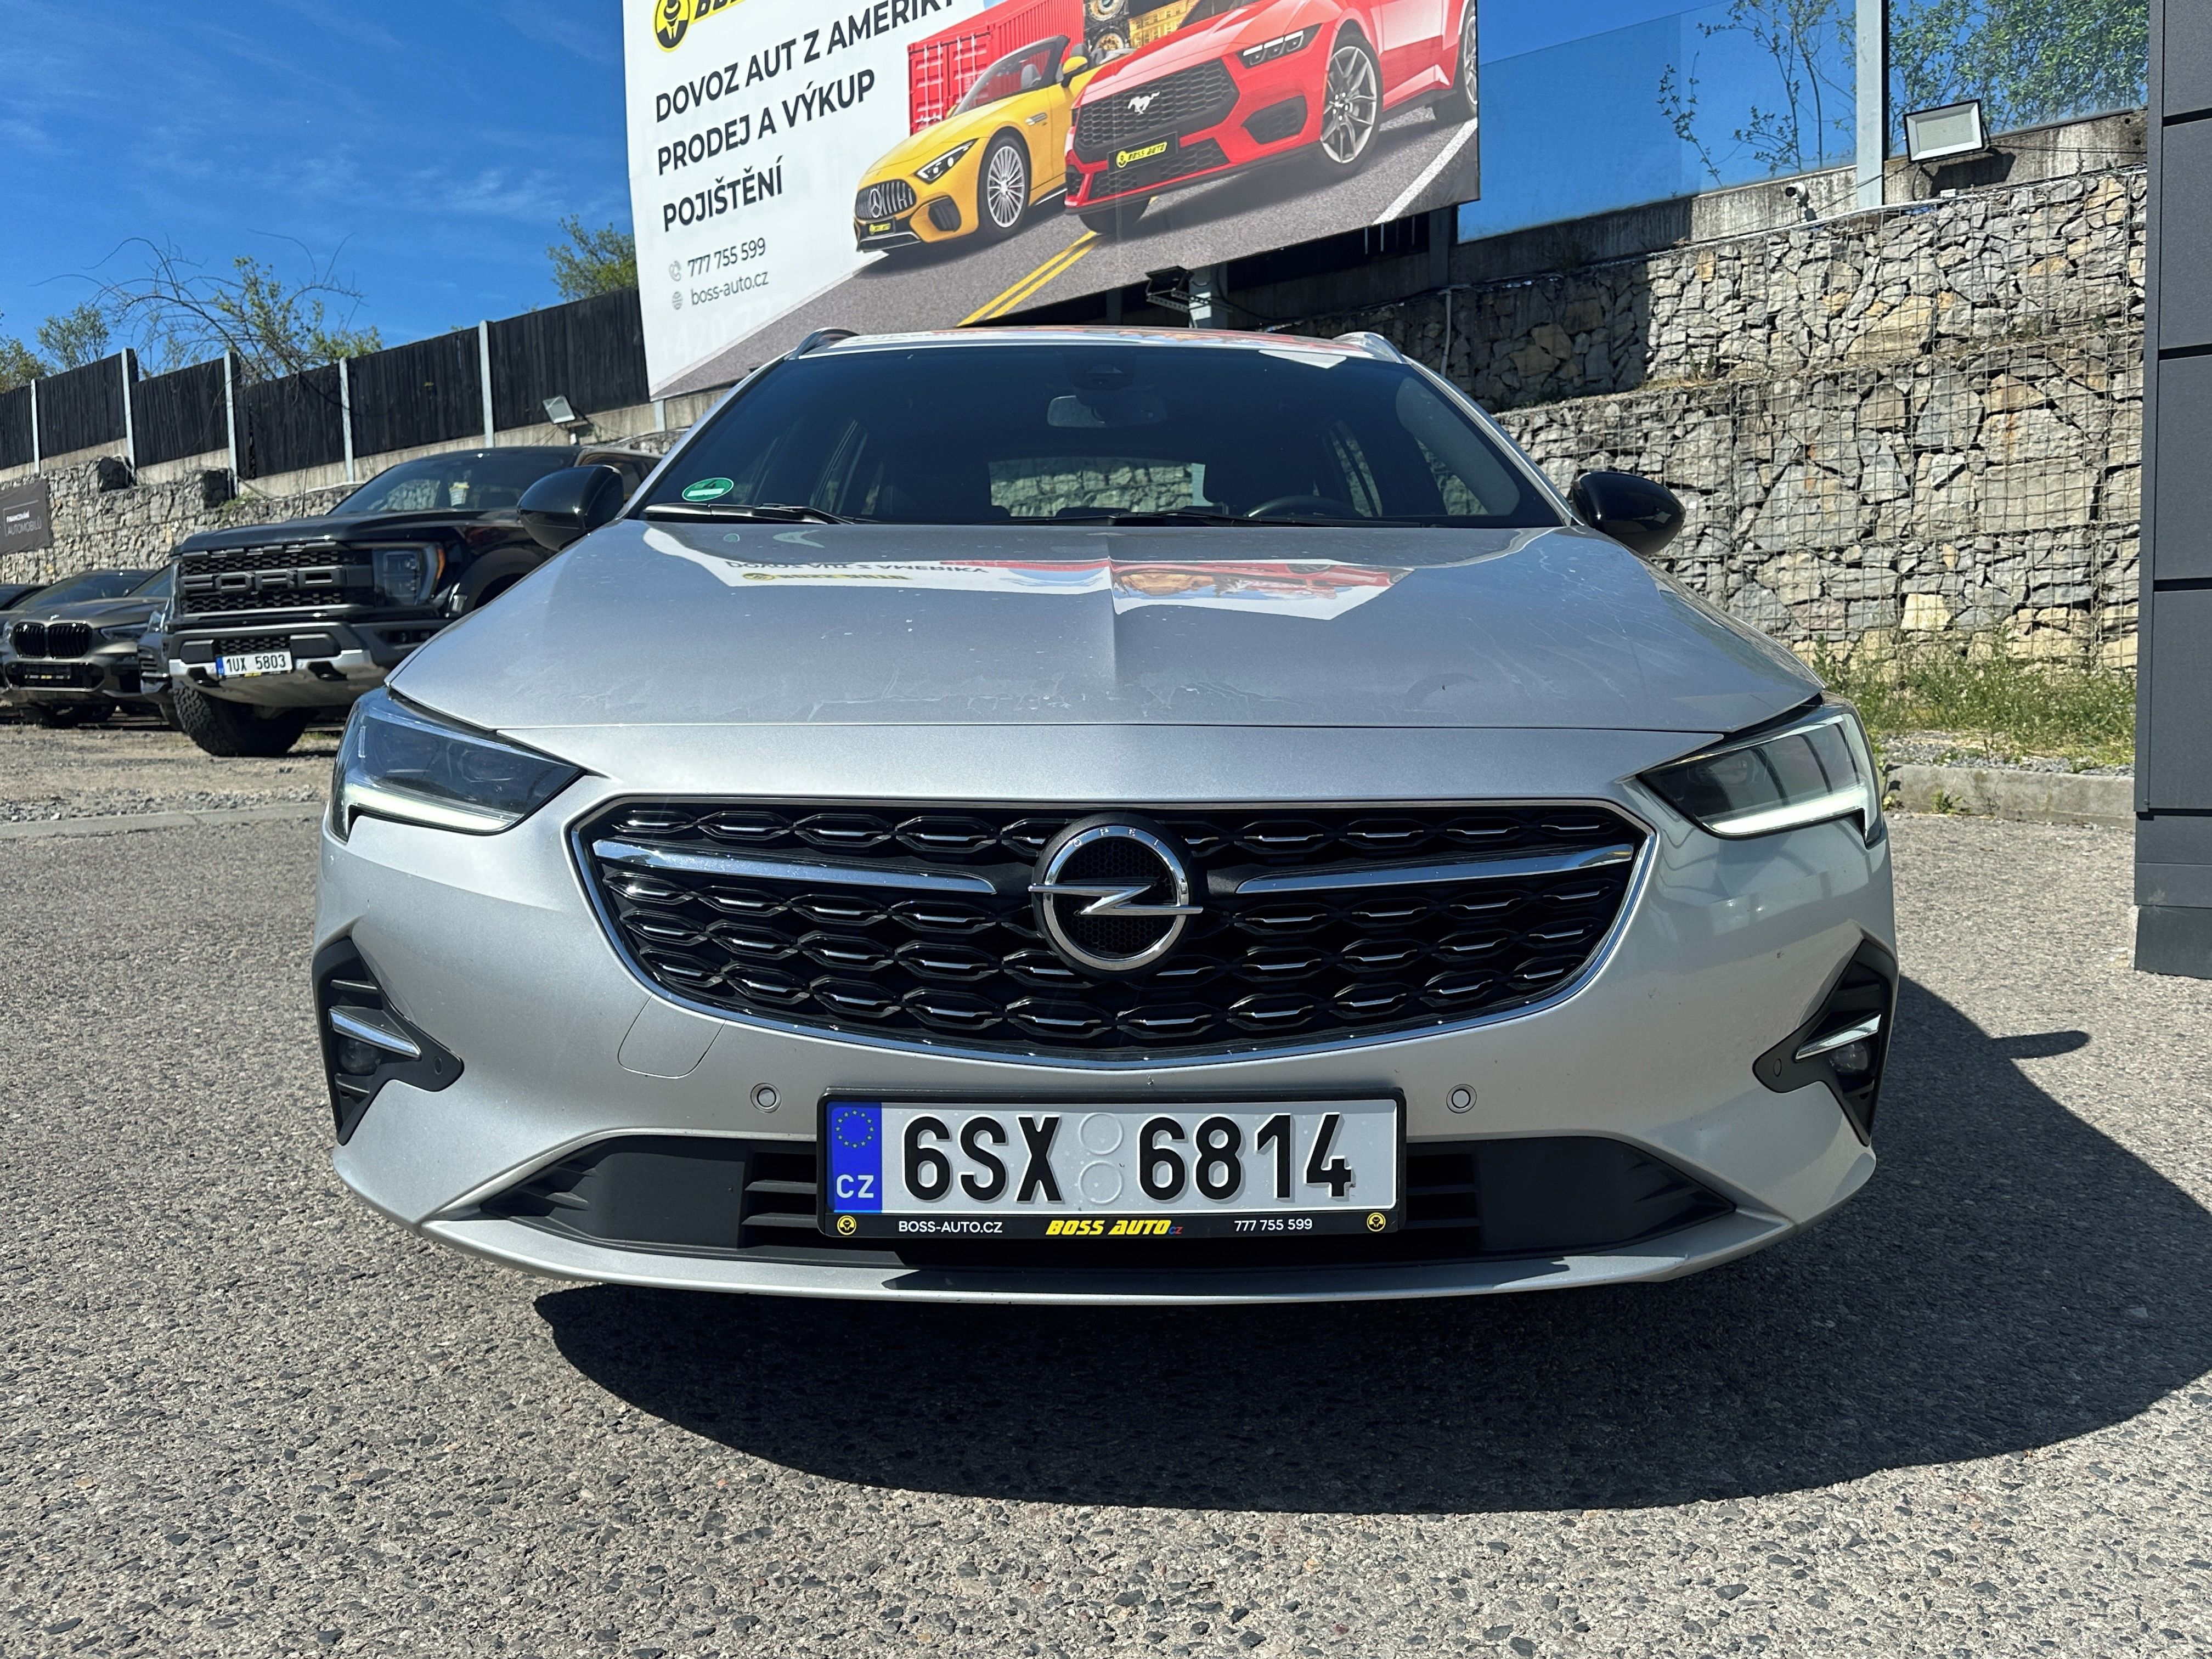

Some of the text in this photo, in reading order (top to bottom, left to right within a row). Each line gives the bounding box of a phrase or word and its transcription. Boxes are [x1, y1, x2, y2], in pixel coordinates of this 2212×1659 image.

[656, 62, 739, 123] DOVOZ
[745, 38, 797, 87] AUT
[804, 29, 820, 64] Z
[658, 69, 875, 176] PRODEJ A VÝKUP
[663, 155, 783, 233] POJIŠTĚNÍ
[687, 238, 766, 277] 777 755 599
[691, 271, 769, 306] boss-auto.cz
[227, 657, 247, 673] 1UX
[255, 654, 285, 670] 5803
[836, 1113, 1353, 1203] CZ 6SX 6814
[899, 1220, 1003, 1234] BOSS-AUTO.CZ
[1045, 1220, 1105, 1235] BOSS
[1107, 1220, 1172, 1235] AUTO
[1234, 1218, 1313, 1232] 777 755 599
